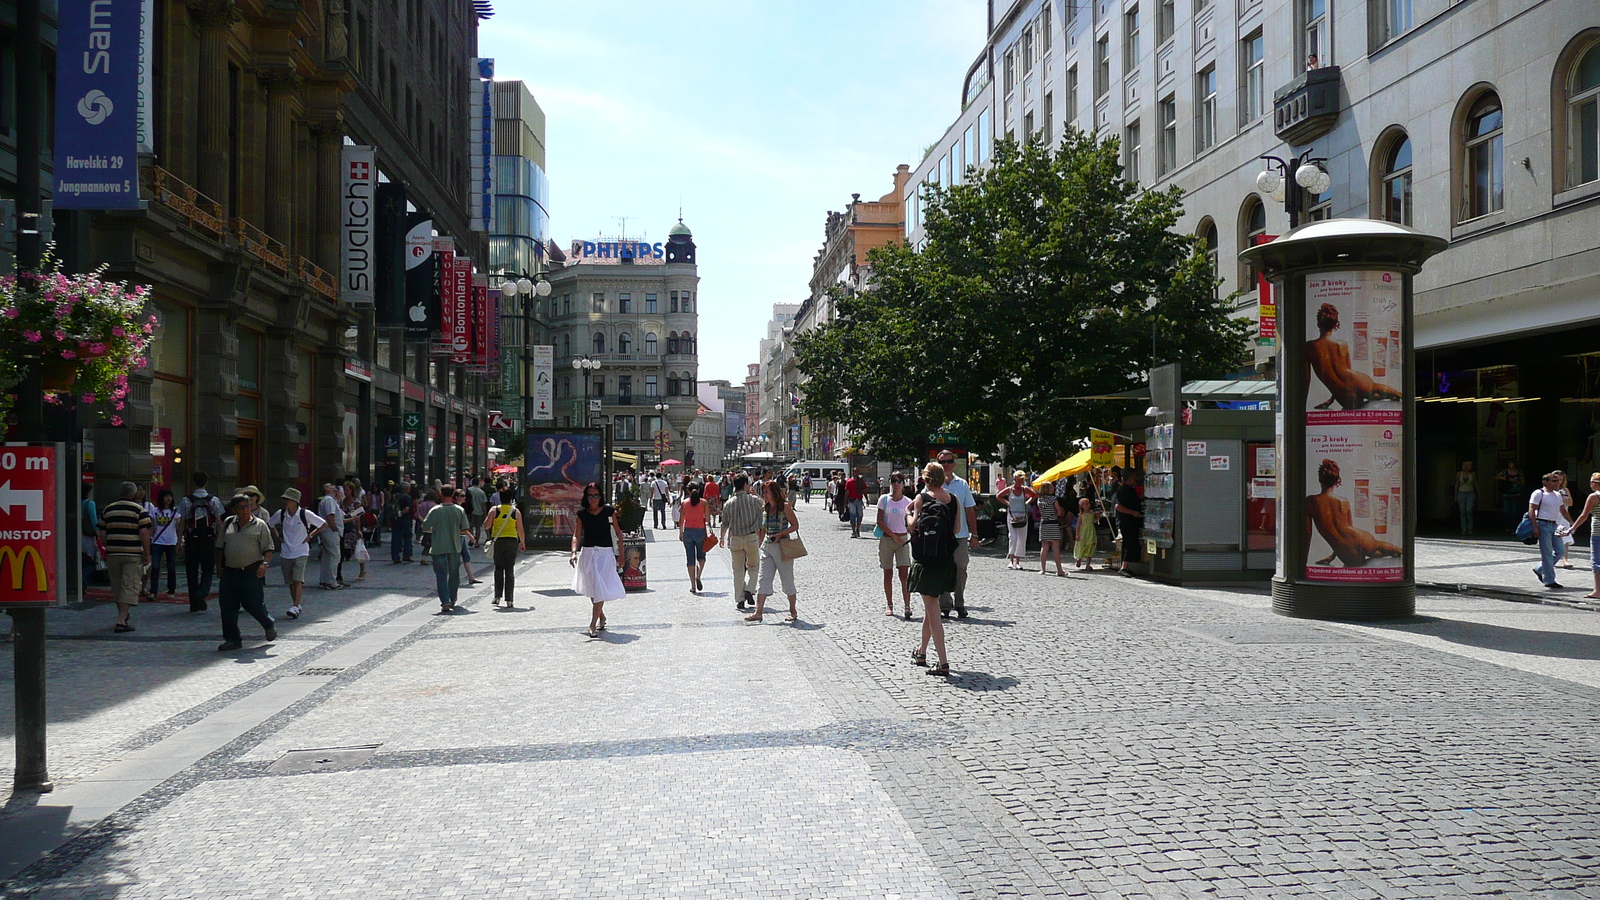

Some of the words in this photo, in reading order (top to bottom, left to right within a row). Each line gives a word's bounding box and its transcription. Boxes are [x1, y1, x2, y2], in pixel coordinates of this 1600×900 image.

[66, 155, 108, 169] Havelská
[110, 155, 124, 169] 29
[58, 179, 121, 196] Jungmannova
[124, 180, 131, 193] 5
[346, 182, 369, 292] swatch
[583, 241, 664, 258] PHILIPS
[443, 252, 451, 324] COLOSEUM
[1321, 279, 1327, 287] 3
[1328, 279, 1347, 287] kroky
[455, 270, 466, 334] Bontonland
[477, 287, 485, 348] COLOSEUM
[504, 348, 513, 364] Inn
[503, 363, 513, 392] Holiday
[1322, 434, 1328, 443] 3
[0, 452, 17, 470] 0
[25, 456, 49, 470] m
[0, 530, 52, 540] NSTOP
